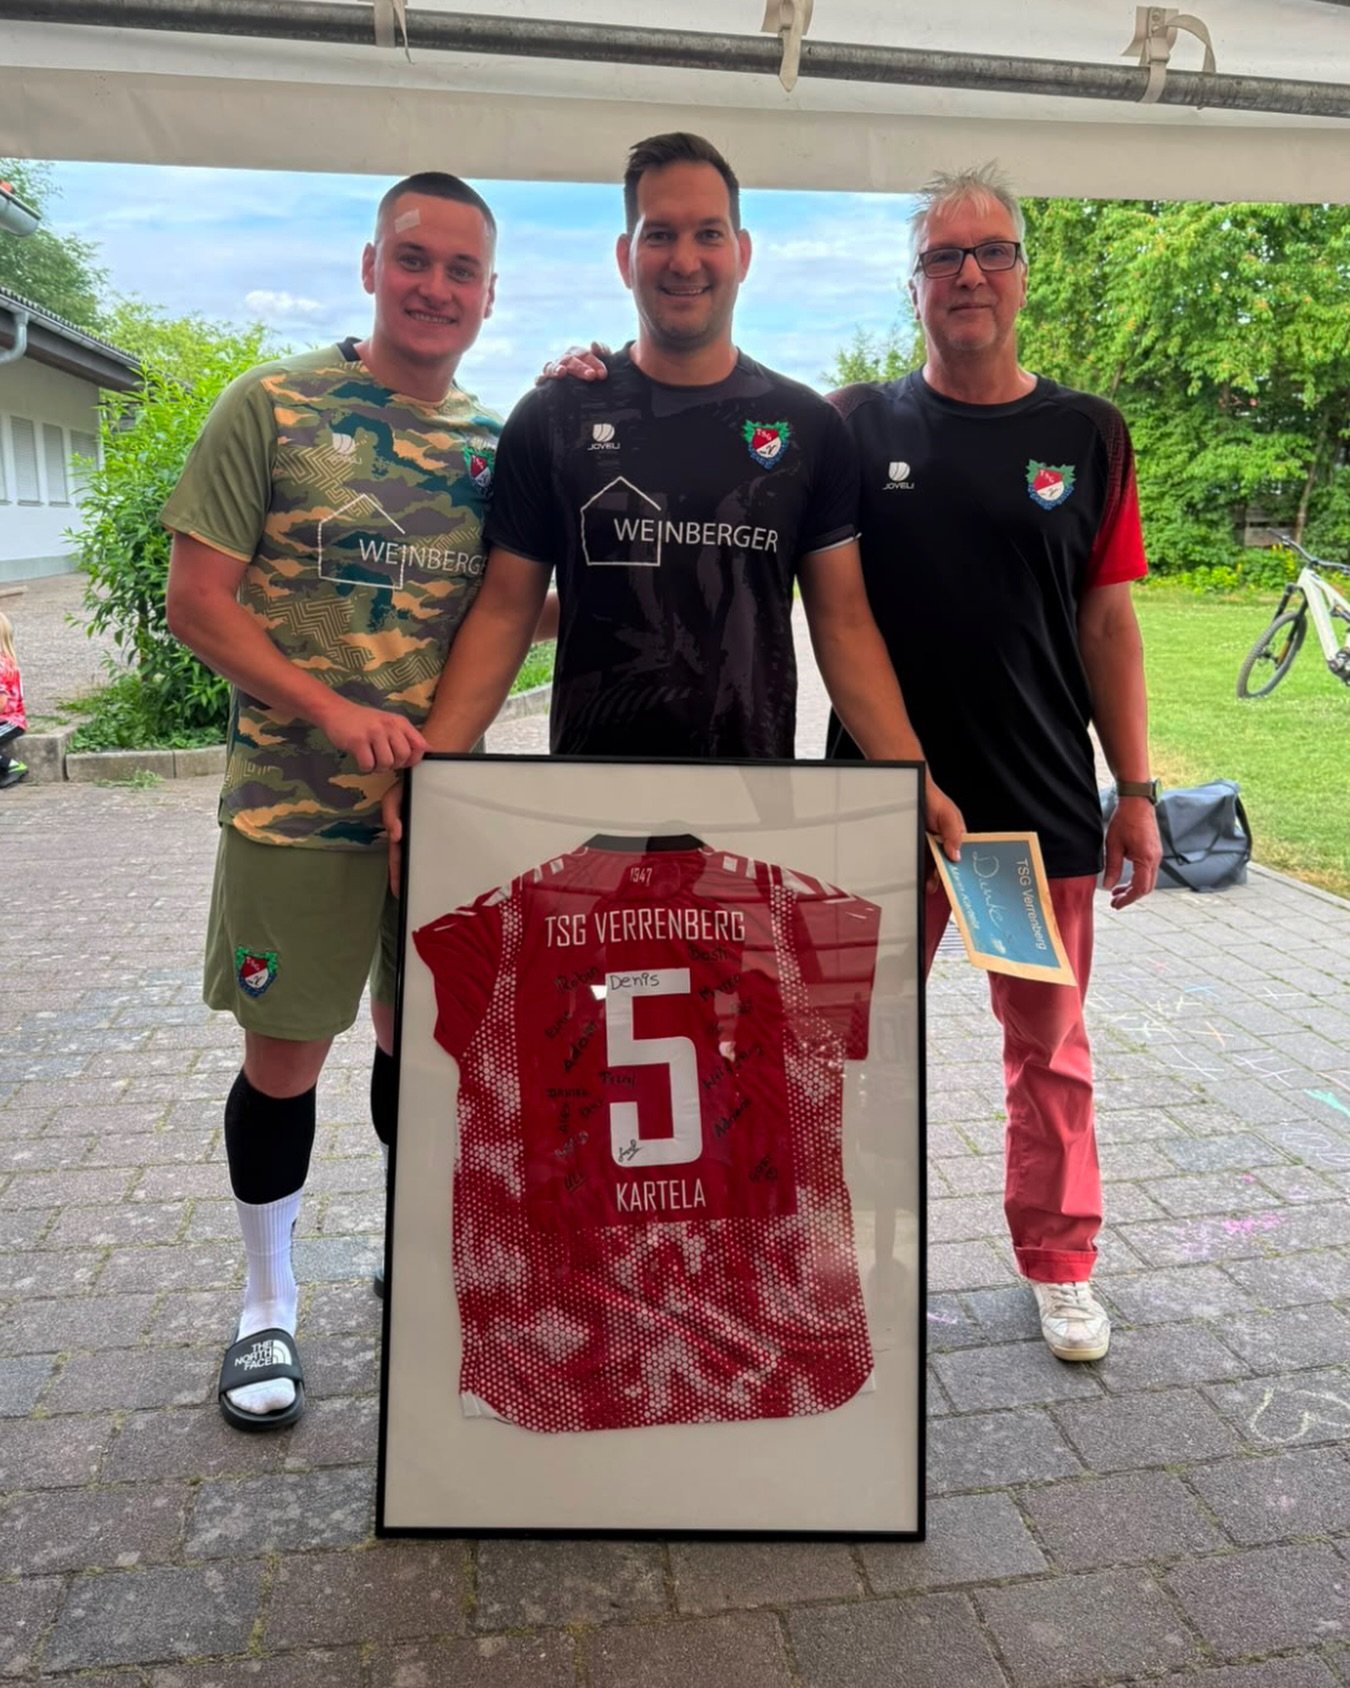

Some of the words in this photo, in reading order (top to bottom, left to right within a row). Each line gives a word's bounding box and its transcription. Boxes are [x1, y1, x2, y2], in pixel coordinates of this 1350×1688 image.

[613, 517, 780, 553] WEINBERGER
[359, 538, 486, 576] WEINBERG
[1016, 858, 1032, 887] TSG
[545, 914, 587, 948] TSG
[594, 907, 746, 944] VERRENBERG
[1022, 889, 1047, 950] Verrenberg
[609, 972, 660, 990] Denis
[605, 967, 704, 1168] 5
[616, 1178, 706, 1212] KARTELA
[234, 1346, 273, 1367] NORTH
[251, 1340, 273, 1353] THE
[243, 1358, 273, 1371] FACE
